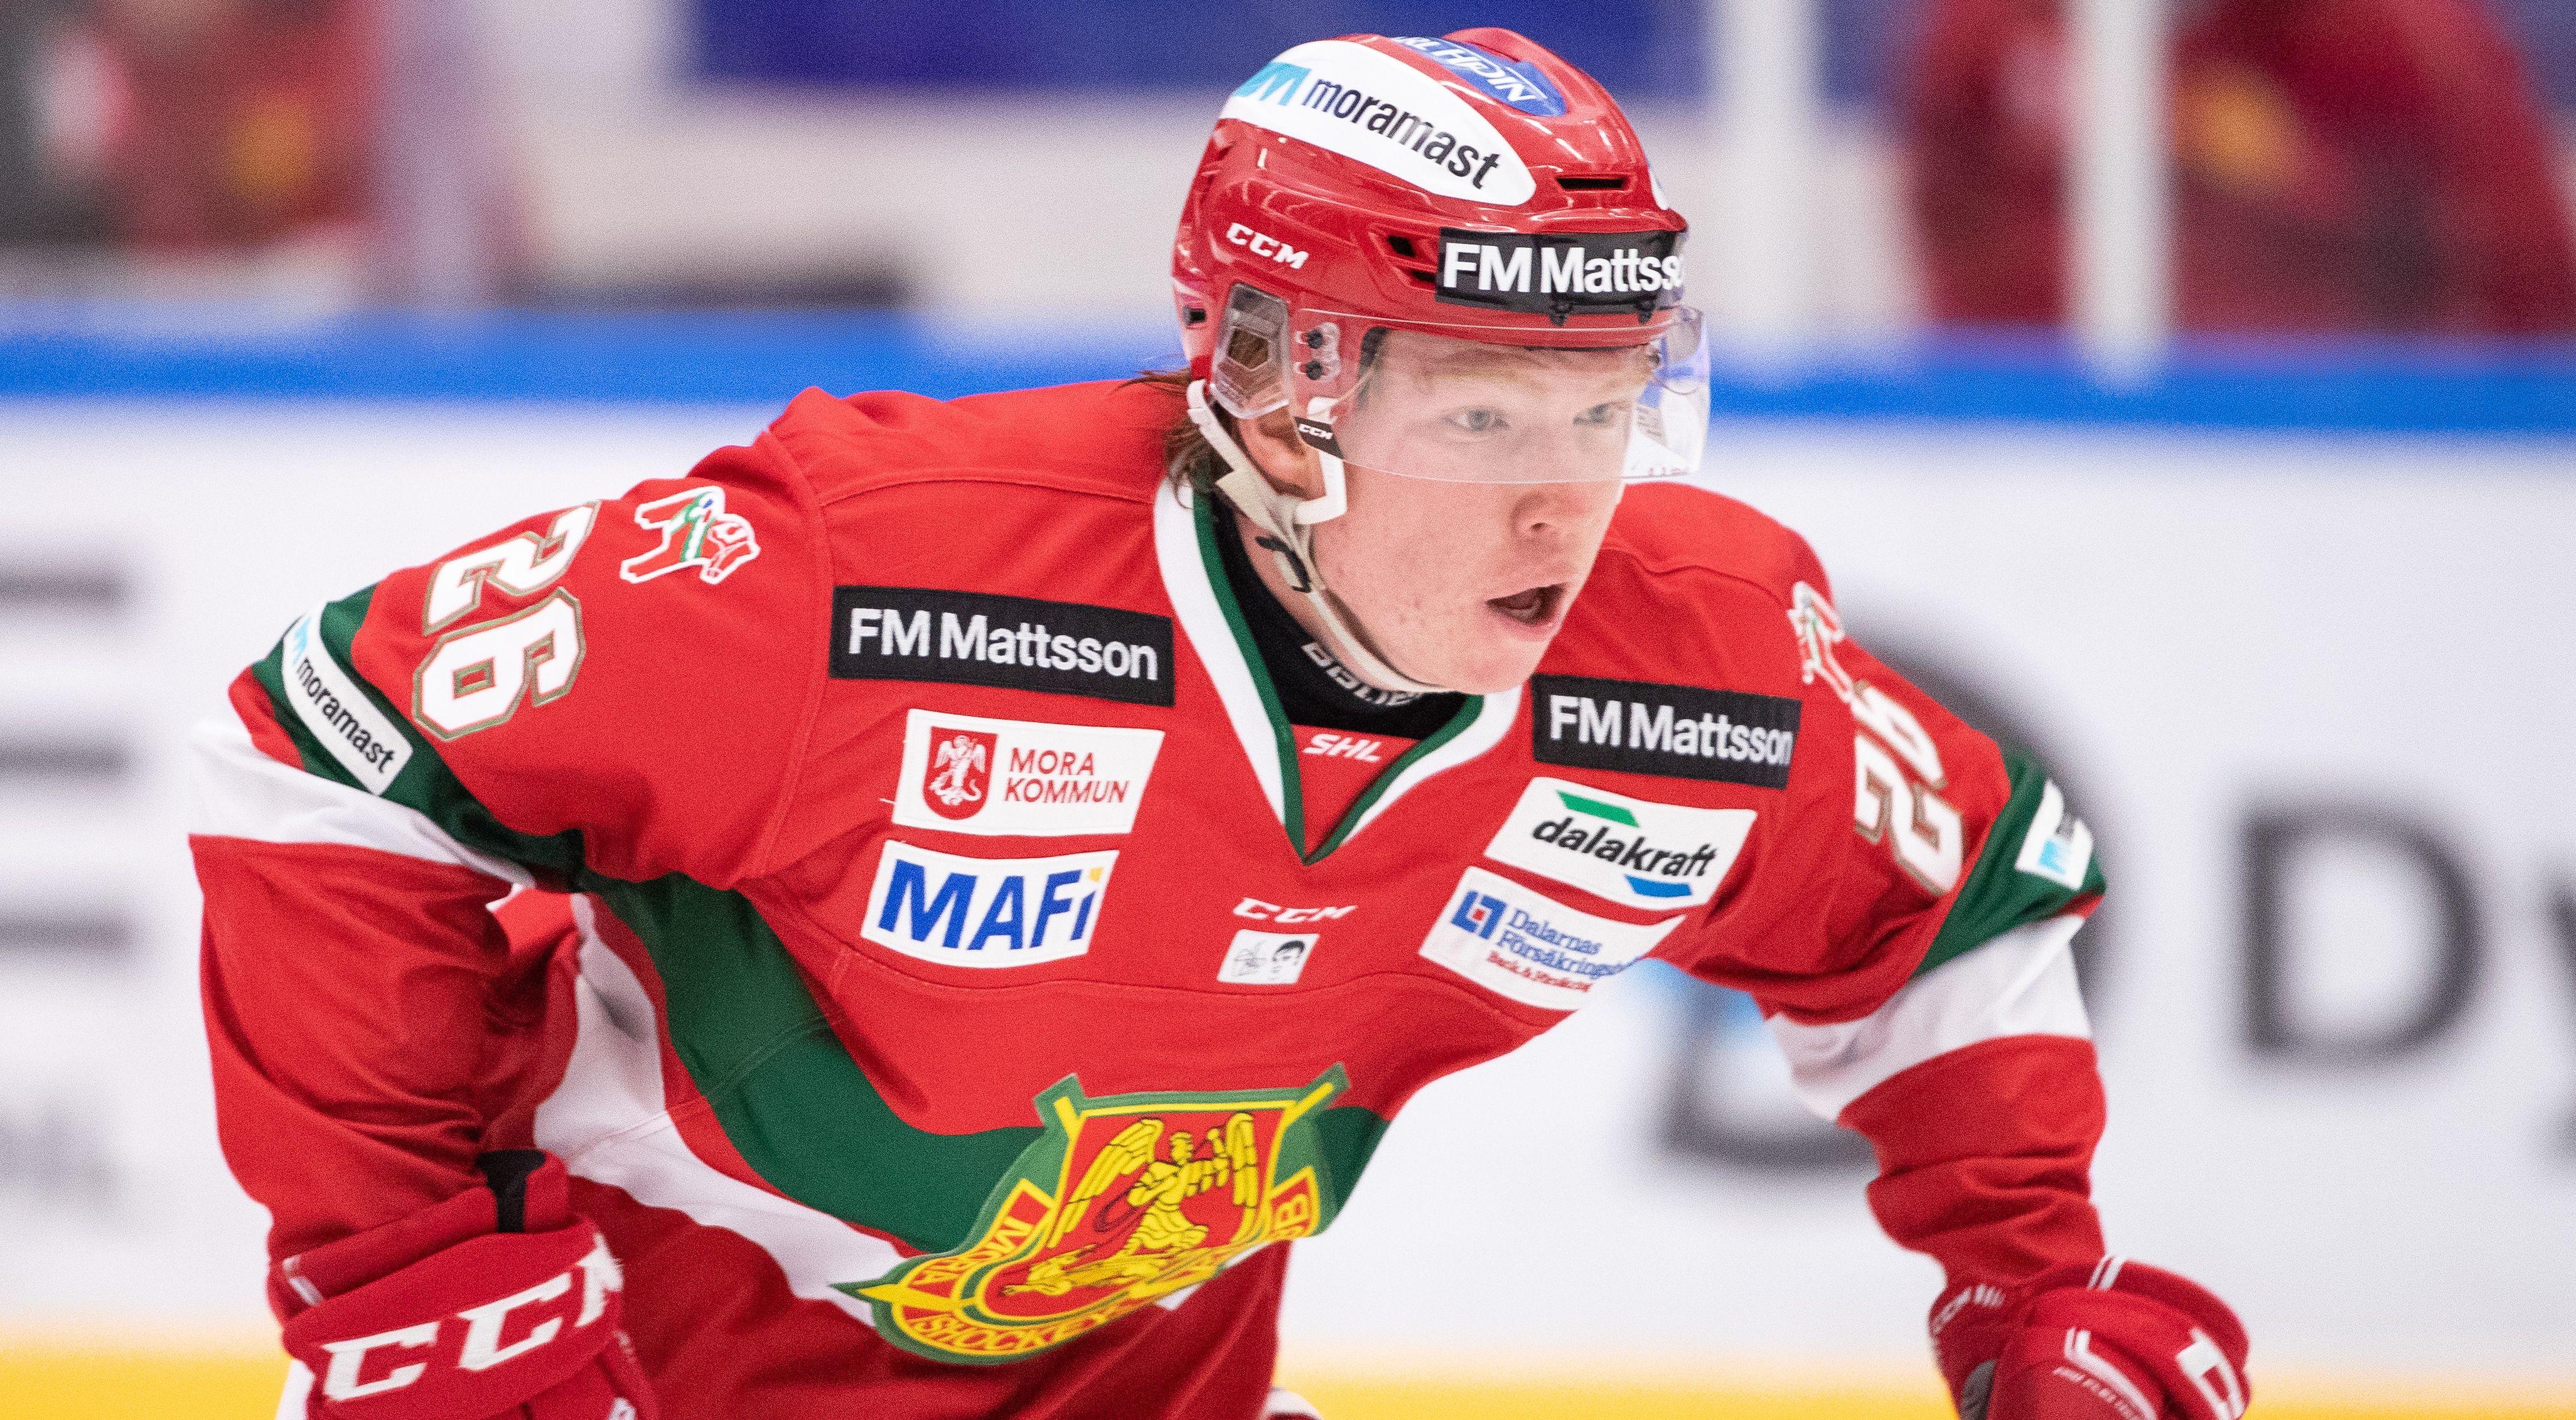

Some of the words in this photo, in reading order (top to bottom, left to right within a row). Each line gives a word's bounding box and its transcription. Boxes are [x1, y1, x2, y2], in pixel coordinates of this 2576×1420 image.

[1302, 78, 1501, 190] moramast
[1226, 222, 1309, 269] CCM
[1443, 242, 1532, 293] FM
[1299, 424, 1333, 439] CCM
[412, 499, 601, 741] 26
[849, 607, 931, 658] FM
[940, 612, 1158, 680] Mattsson
[296, 657, 395, 774] moramast
[1550, 695, 1622, 747] FM
[1629, 702, 1794, 766] Mattsson
[1009, 747, 1095, 776] MORA
[1302, 733, 1382, 762] SHL
[1004, 778, 1129, 804] KOMMUN
[1851, 680, 1965, 897] 26
[1532, 816, 1717, 877] dalakraft
[1233, 897, 1358, 923] CCM
[1507, 908, 1602, 954] Dalarnas
